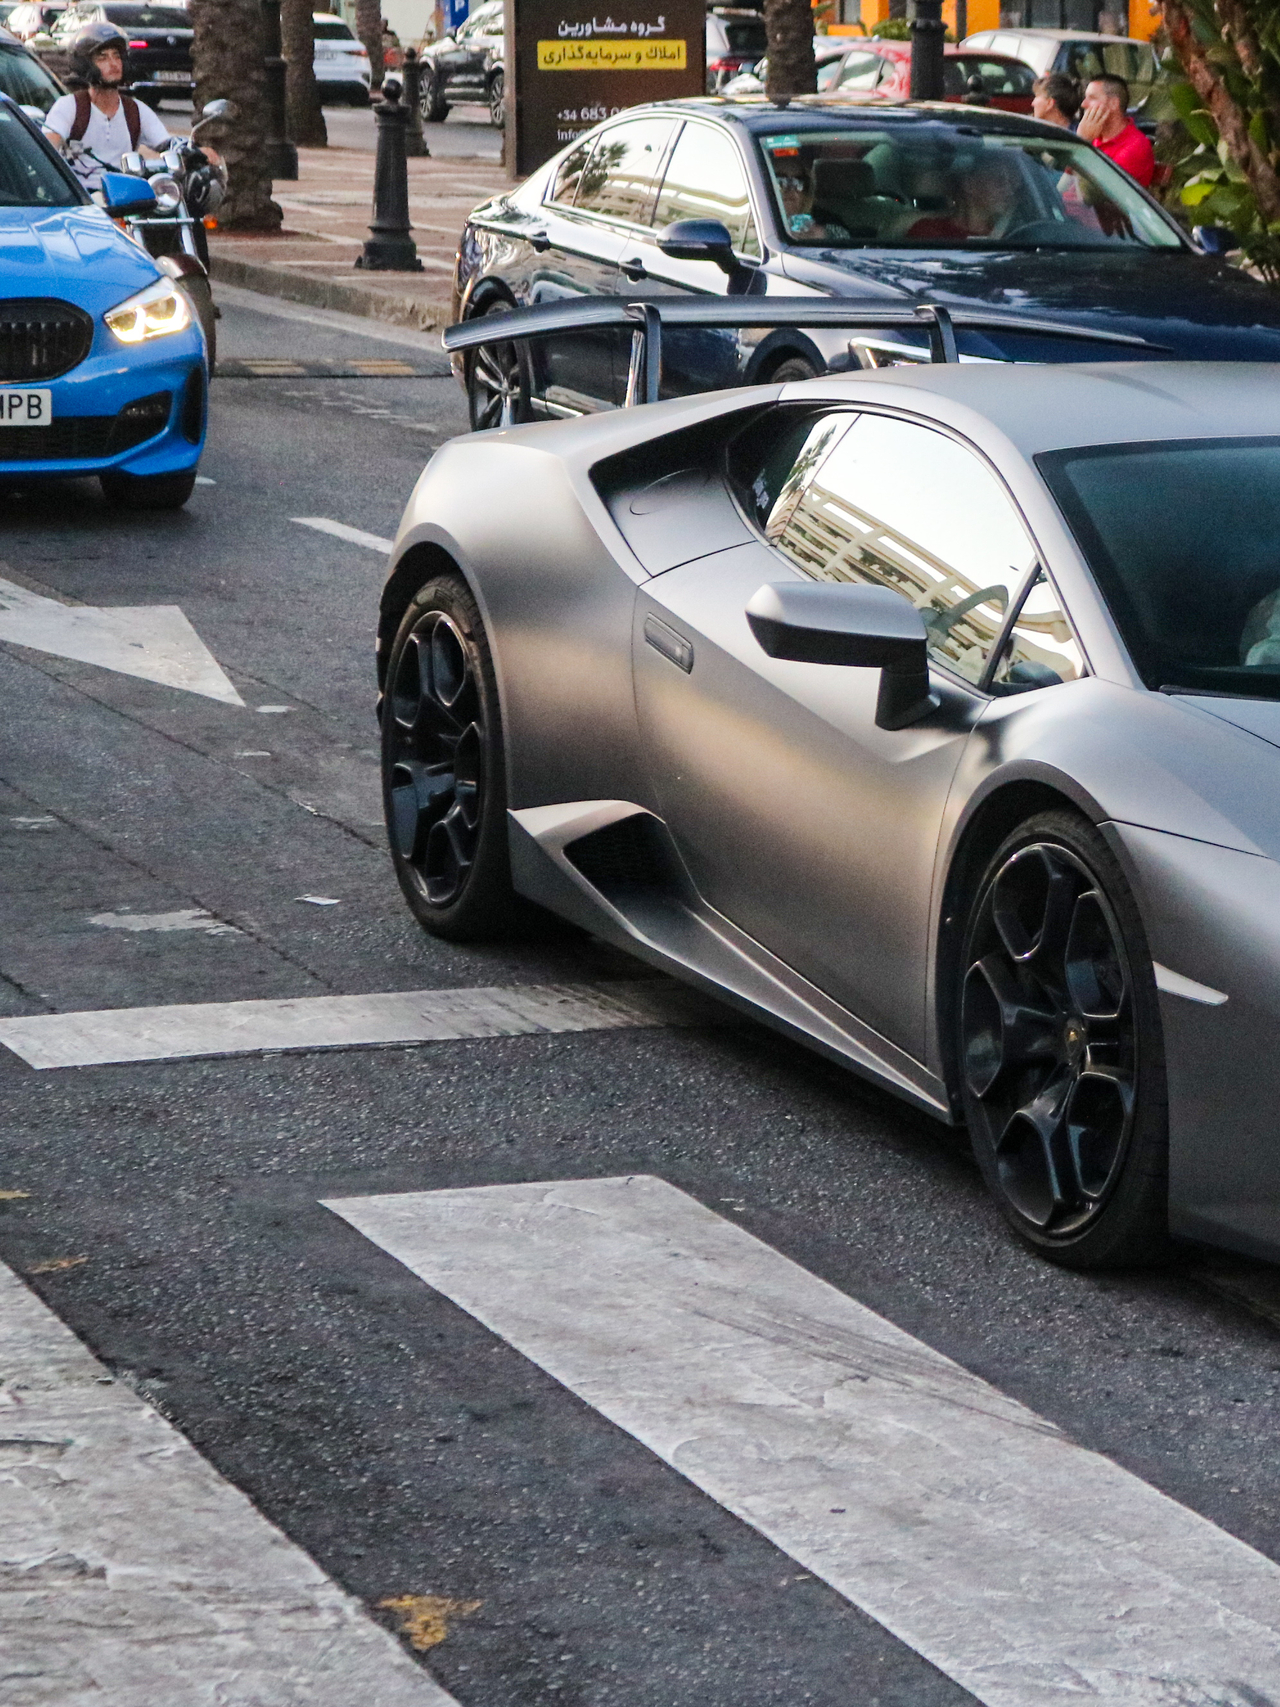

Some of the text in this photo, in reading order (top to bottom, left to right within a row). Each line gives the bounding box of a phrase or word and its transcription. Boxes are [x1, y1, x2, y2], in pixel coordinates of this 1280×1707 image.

[630, 15, 666, 37] گروه
[580, 107, 607, 121] 683
[0, 394, 42, 419] PB
